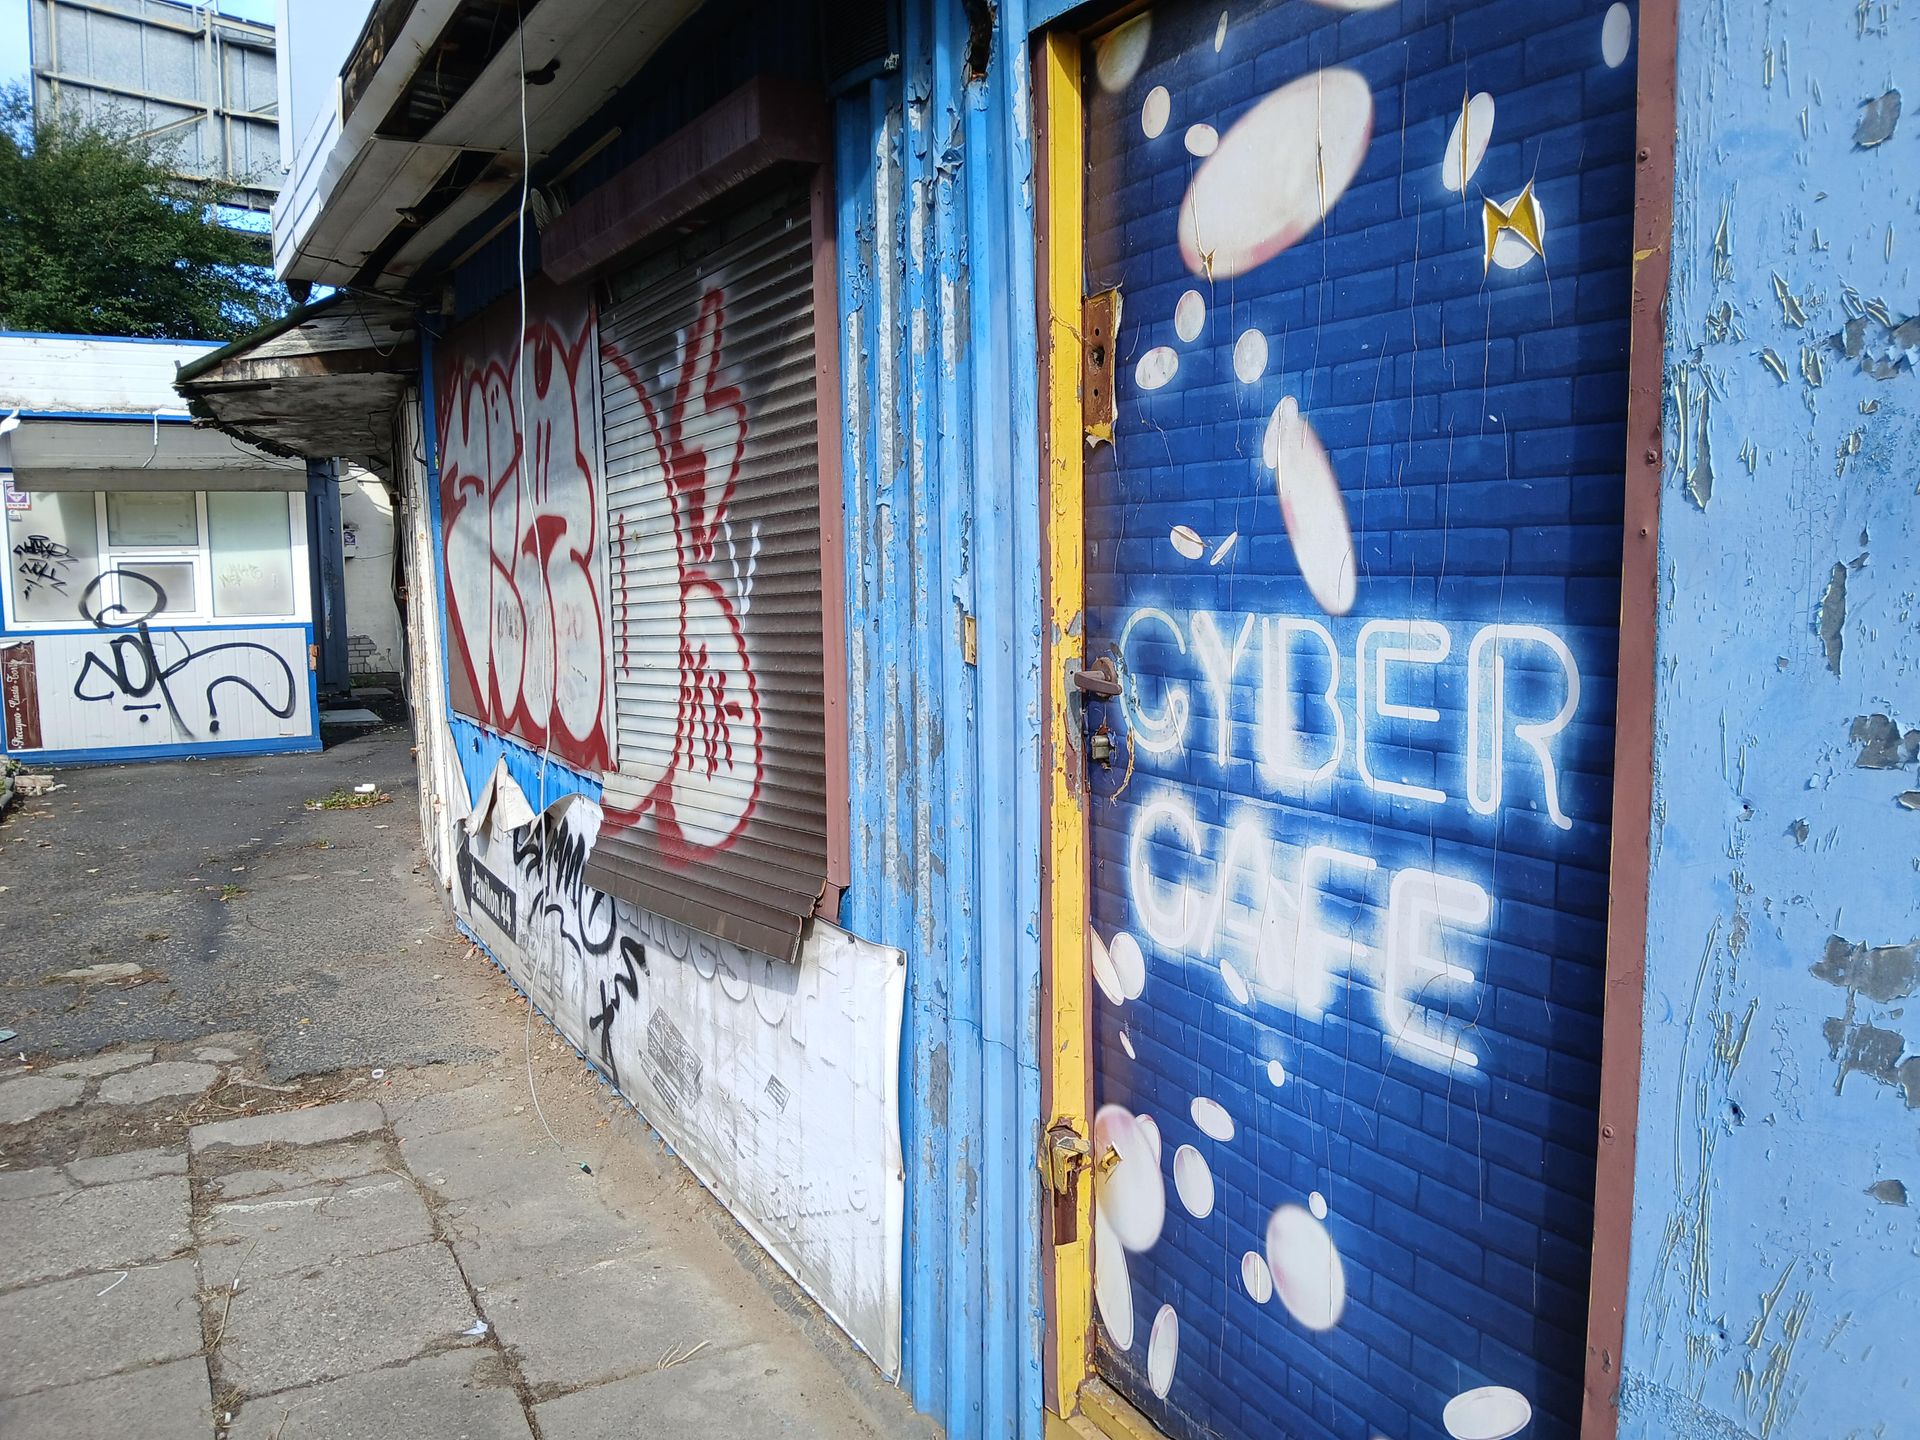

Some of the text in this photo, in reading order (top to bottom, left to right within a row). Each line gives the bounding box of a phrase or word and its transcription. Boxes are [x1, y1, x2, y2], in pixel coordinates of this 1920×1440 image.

[1119, 606, 1581, 831] CYBER
[471, 862, 512, 932] Pawilon 44
[1129, 800, 1490, 1068] CAFE
